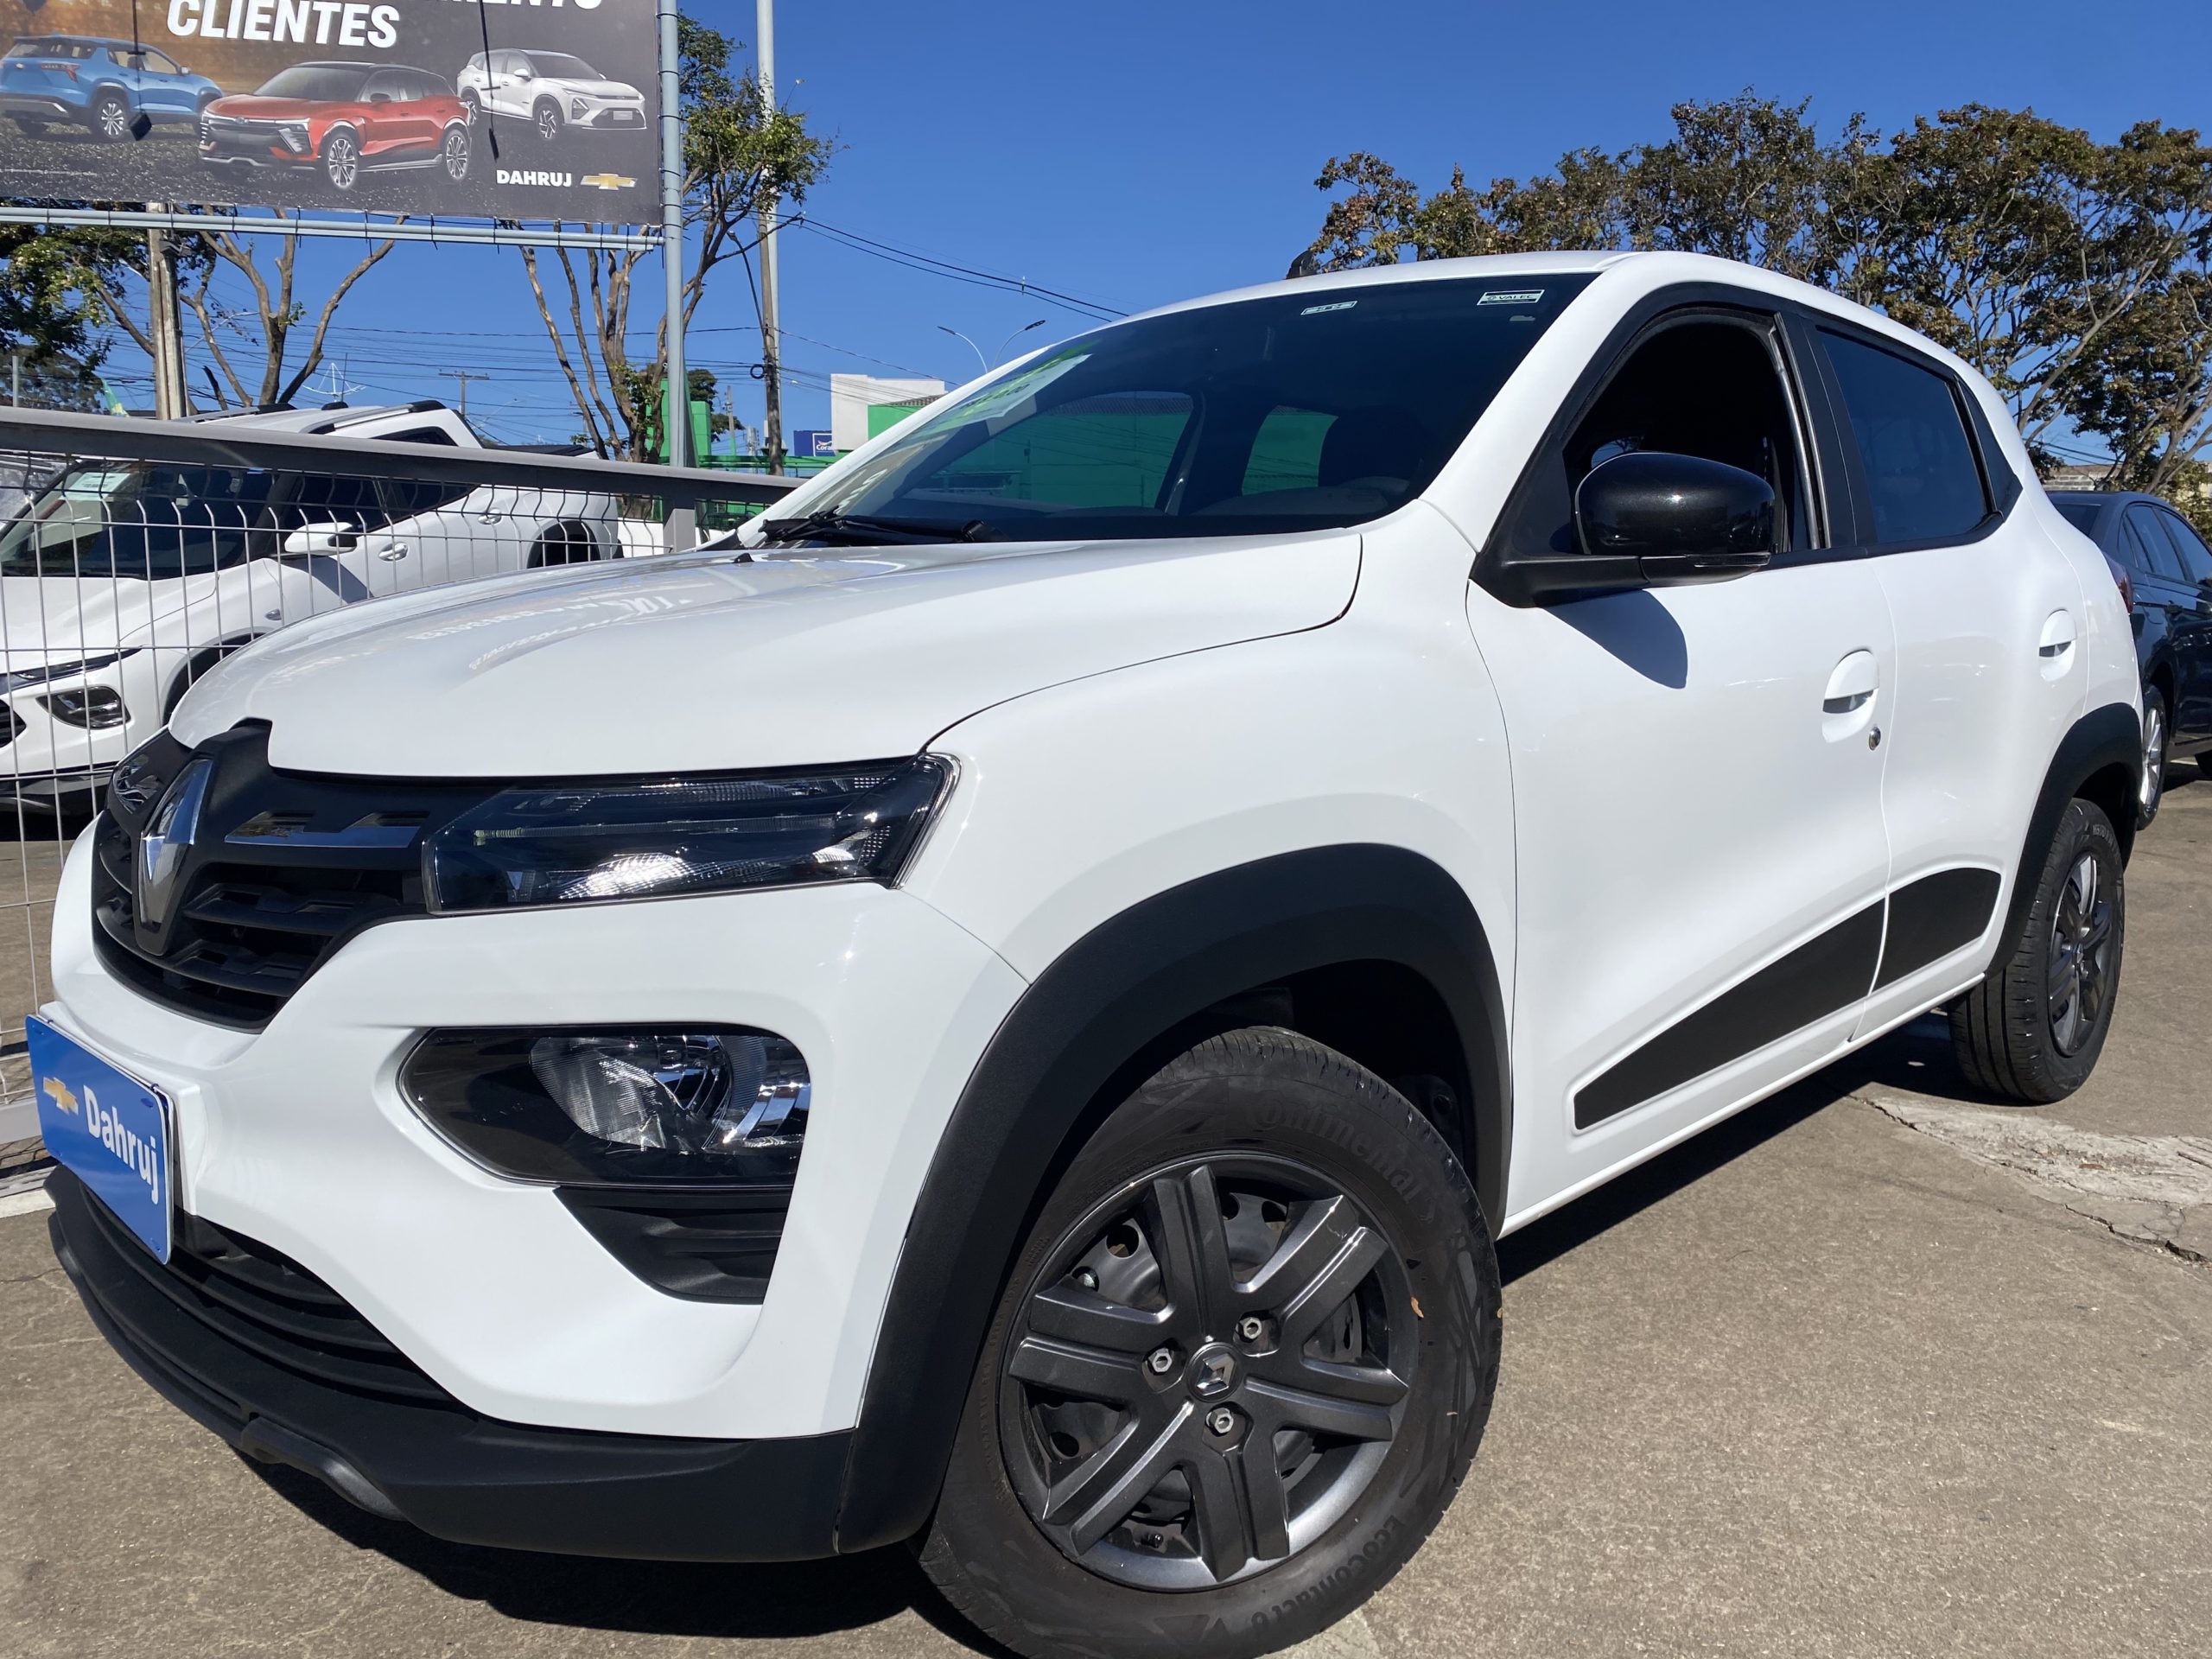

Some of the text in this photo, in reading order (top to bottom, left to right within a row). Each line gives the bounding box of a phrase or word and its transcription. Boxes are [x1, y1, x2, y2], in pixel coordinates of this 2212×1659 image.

[167, 0, 400, 48] CLIENTES
[496, 169, 572, 188] DAHRUJ
[83, 1085, 159, 1205] Dahruj
